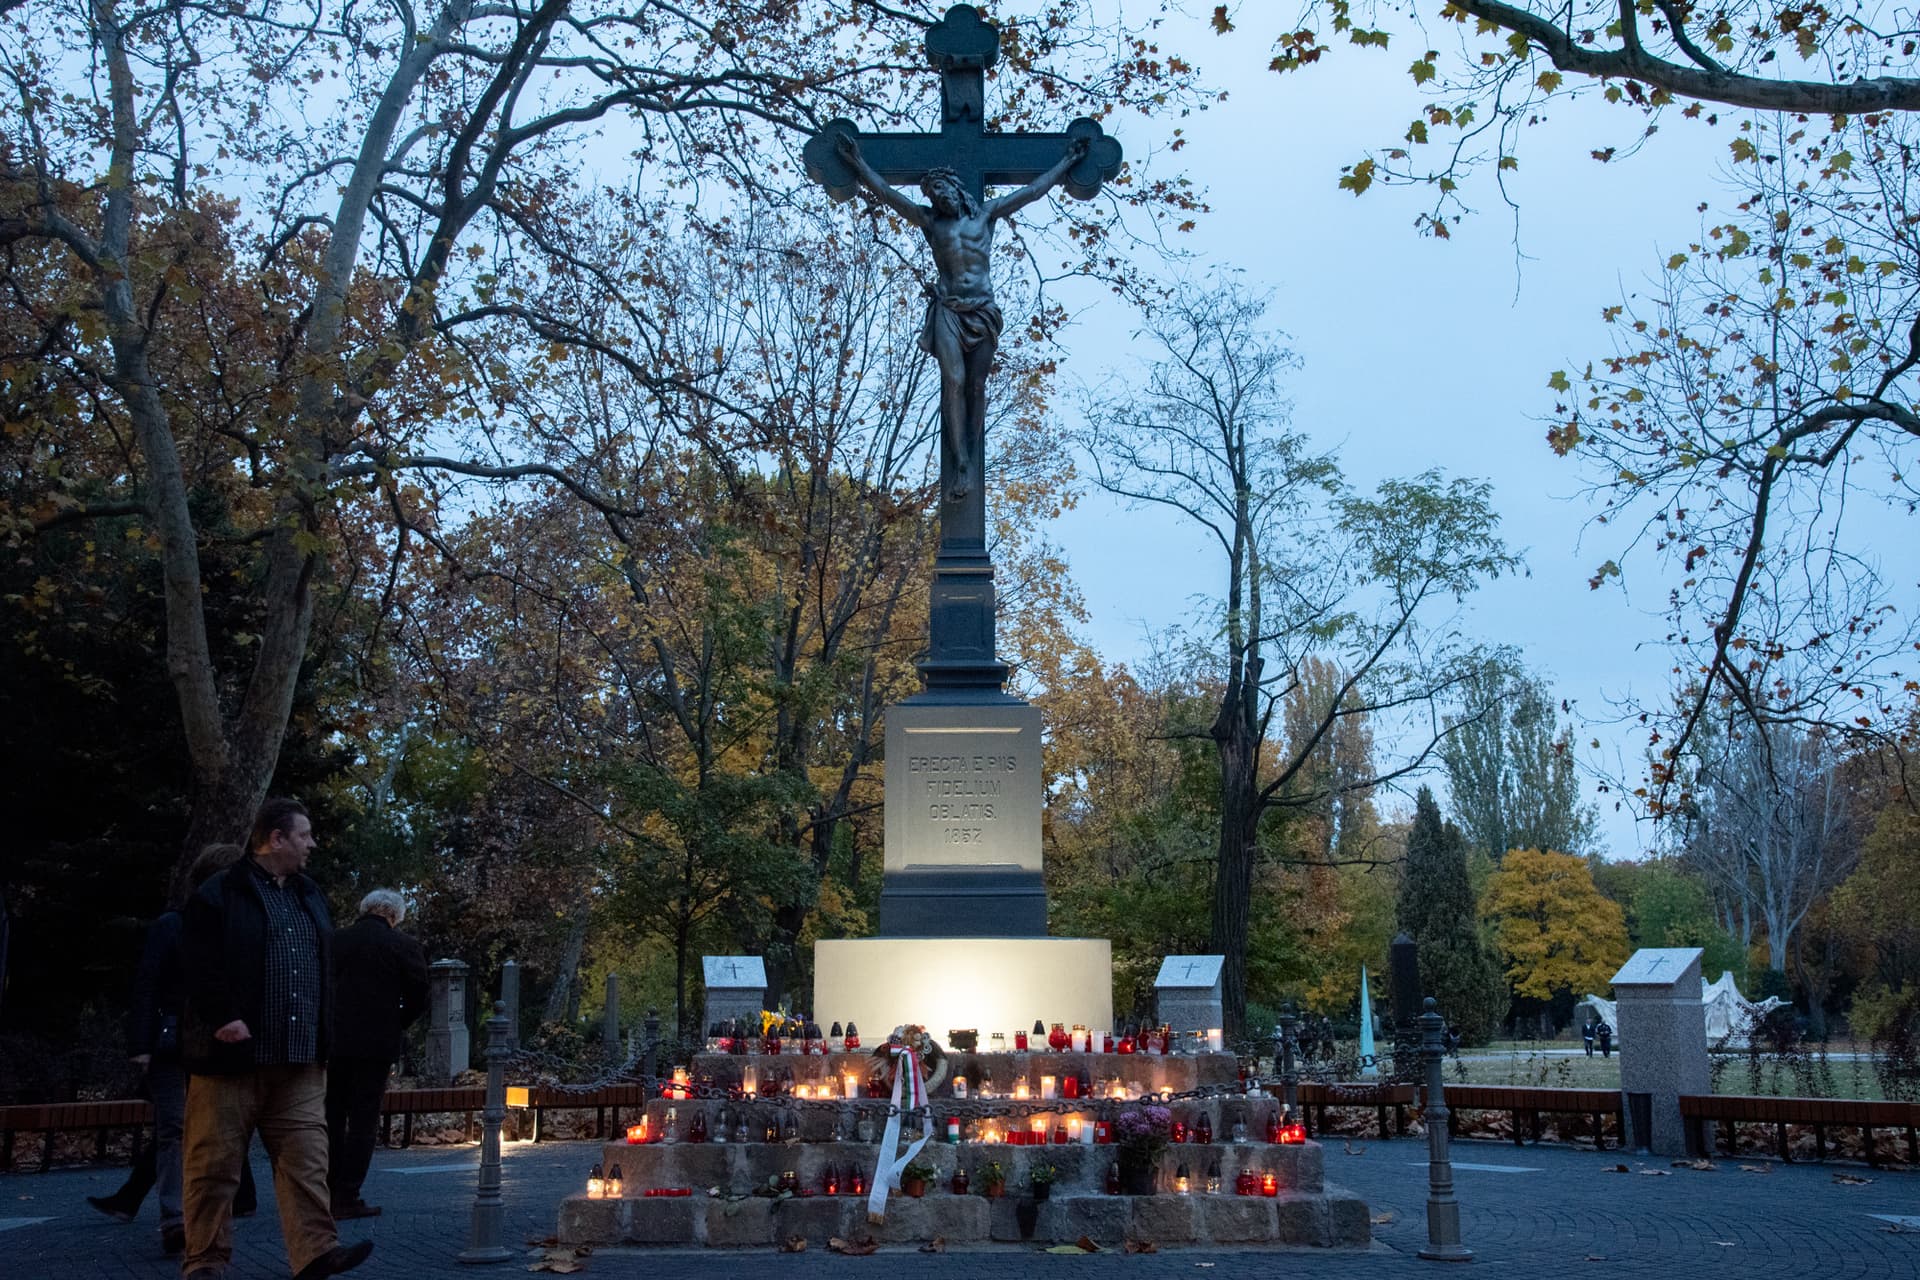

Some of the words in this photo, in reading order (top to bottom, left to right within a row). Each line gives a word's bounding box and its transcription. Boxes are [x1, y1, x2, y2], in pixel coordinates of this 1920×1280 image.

[909, 756, 969, 773] ERECTA
[973, 756, 984, 773] E
[927, 780, 1001, 798] FIDELIUM
